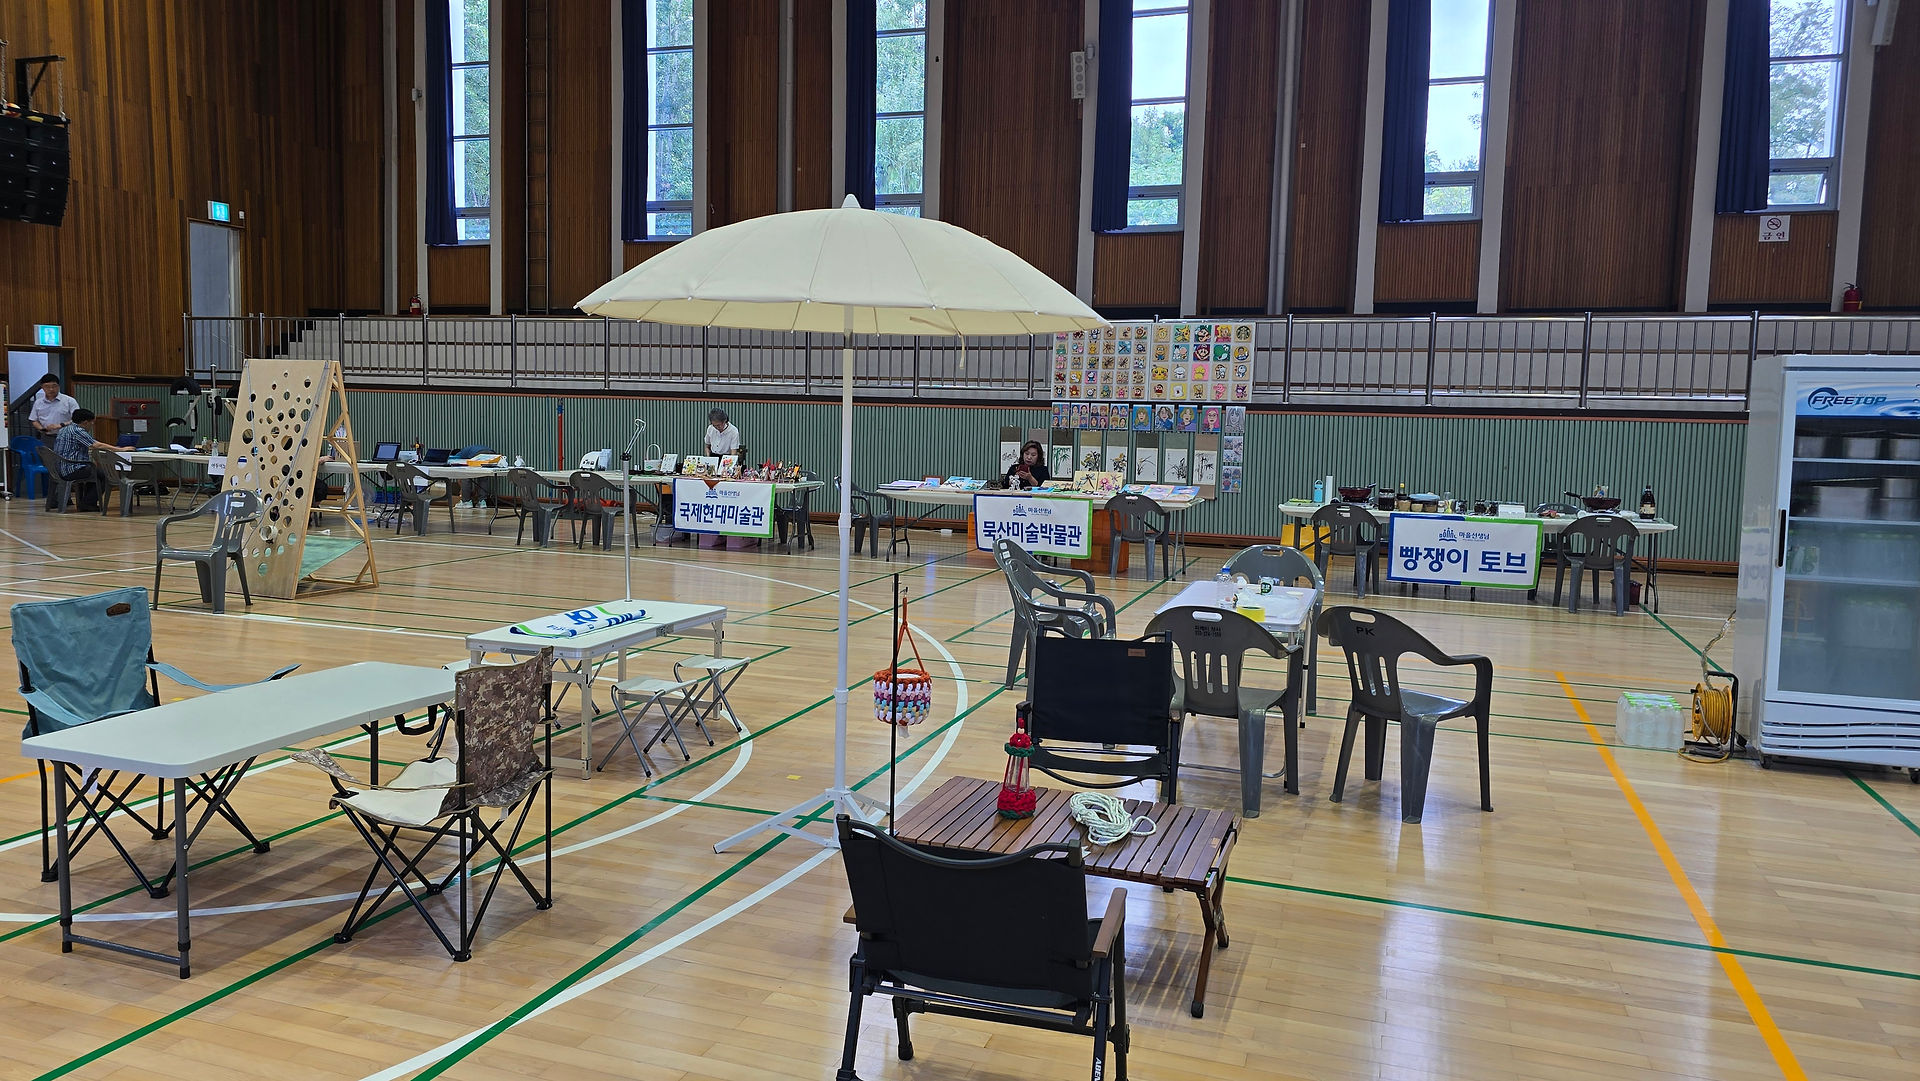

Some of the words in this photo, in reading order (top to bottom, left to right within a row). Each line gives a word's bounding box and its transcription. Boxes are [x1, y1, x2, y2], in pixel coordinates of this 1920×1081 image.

[1811, 396, 1887, 407] FREETOP
[679, 502, 764, 526] 국제현대미술관
[982, 521, 1082, 547] 묵산미술박물관
[1458, 531, 1490, 539] 마을선생님
[1399, 545, 1469, 573] 빵쟁이
[1478, 550, 1528, 574] 토브
[1356, 626, 1376, 636] PK
